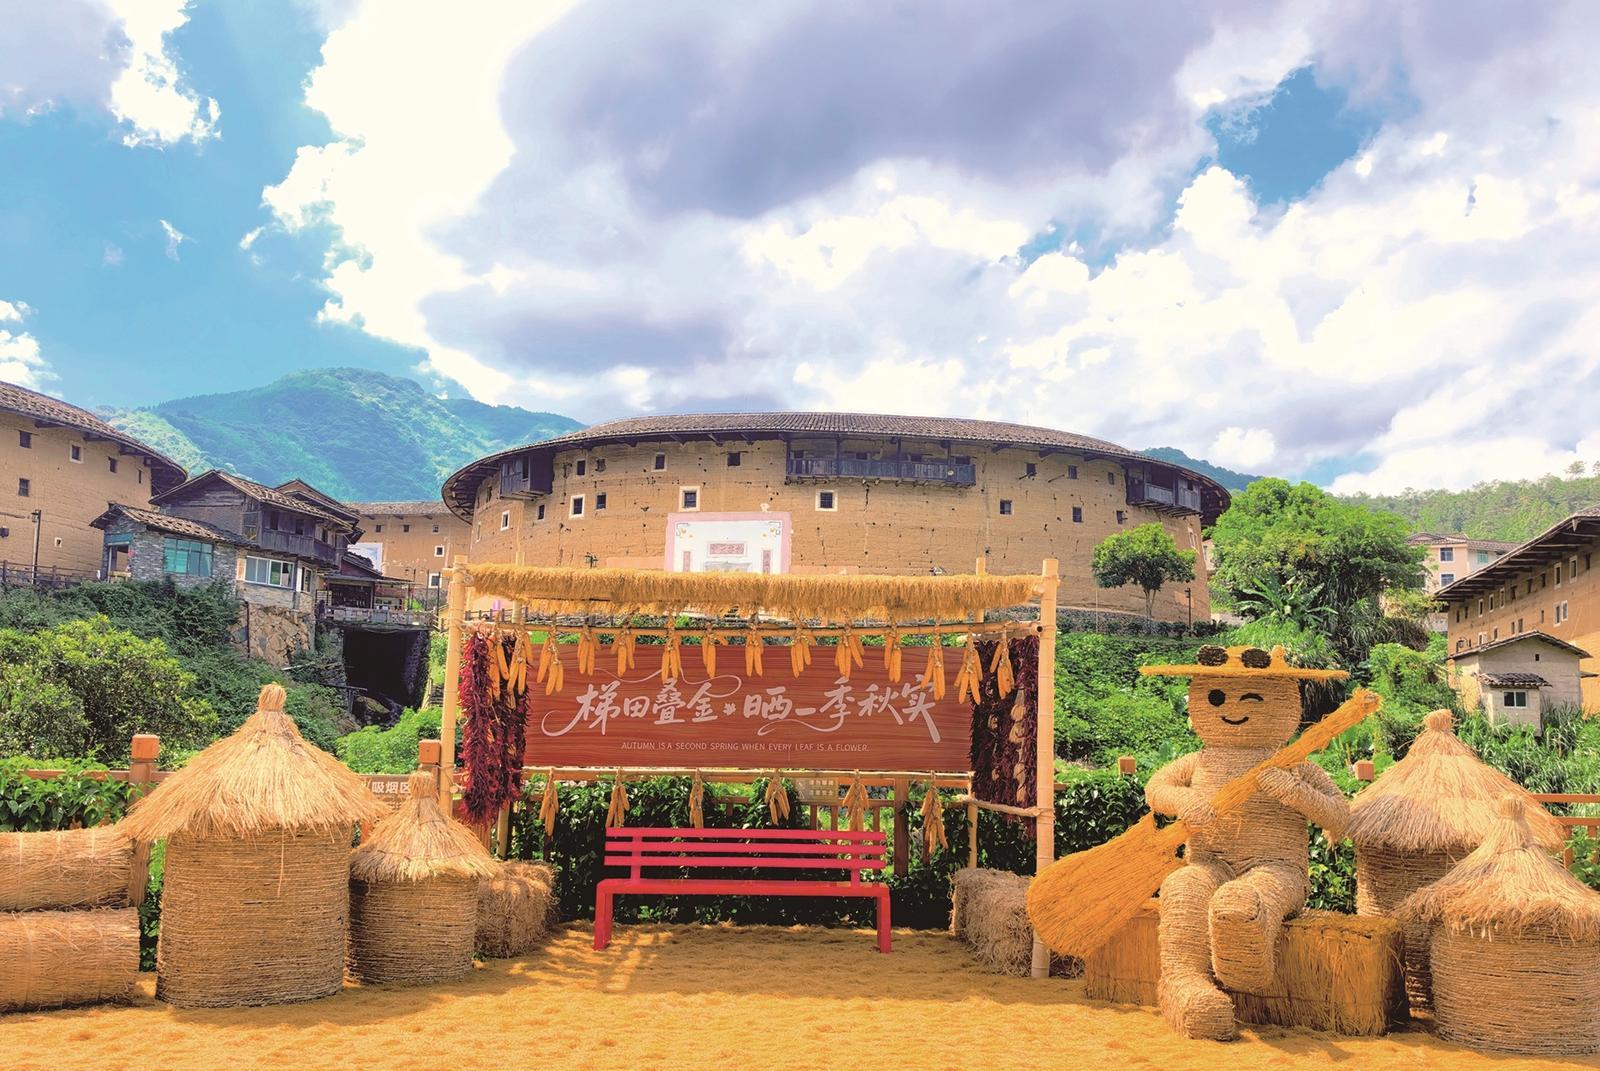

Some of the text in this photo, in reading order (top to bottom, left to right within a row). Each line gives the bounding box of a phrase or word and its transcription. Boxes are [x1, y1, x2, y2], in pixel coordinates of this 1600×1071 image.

[541, 674, 941, 744] 梯田叠金 晒一季秋实
[622, 742, 655, 750] AUTUMN
[658, 742, 666, 750] IS
[666, 742, 673, 750] A
[675, 742, 707, 750] SECOND
[709, 742, 739, 751] SPRING
[741, 743, 765, 751] WHEN
[768, 743, 792, 751] EVERY
[795, 743, 814, 751] LEAF
[816, 743, 825, 752] IS
[827, 743, 834, 752] A
[372, 781, 411, 794] 吸烟区
